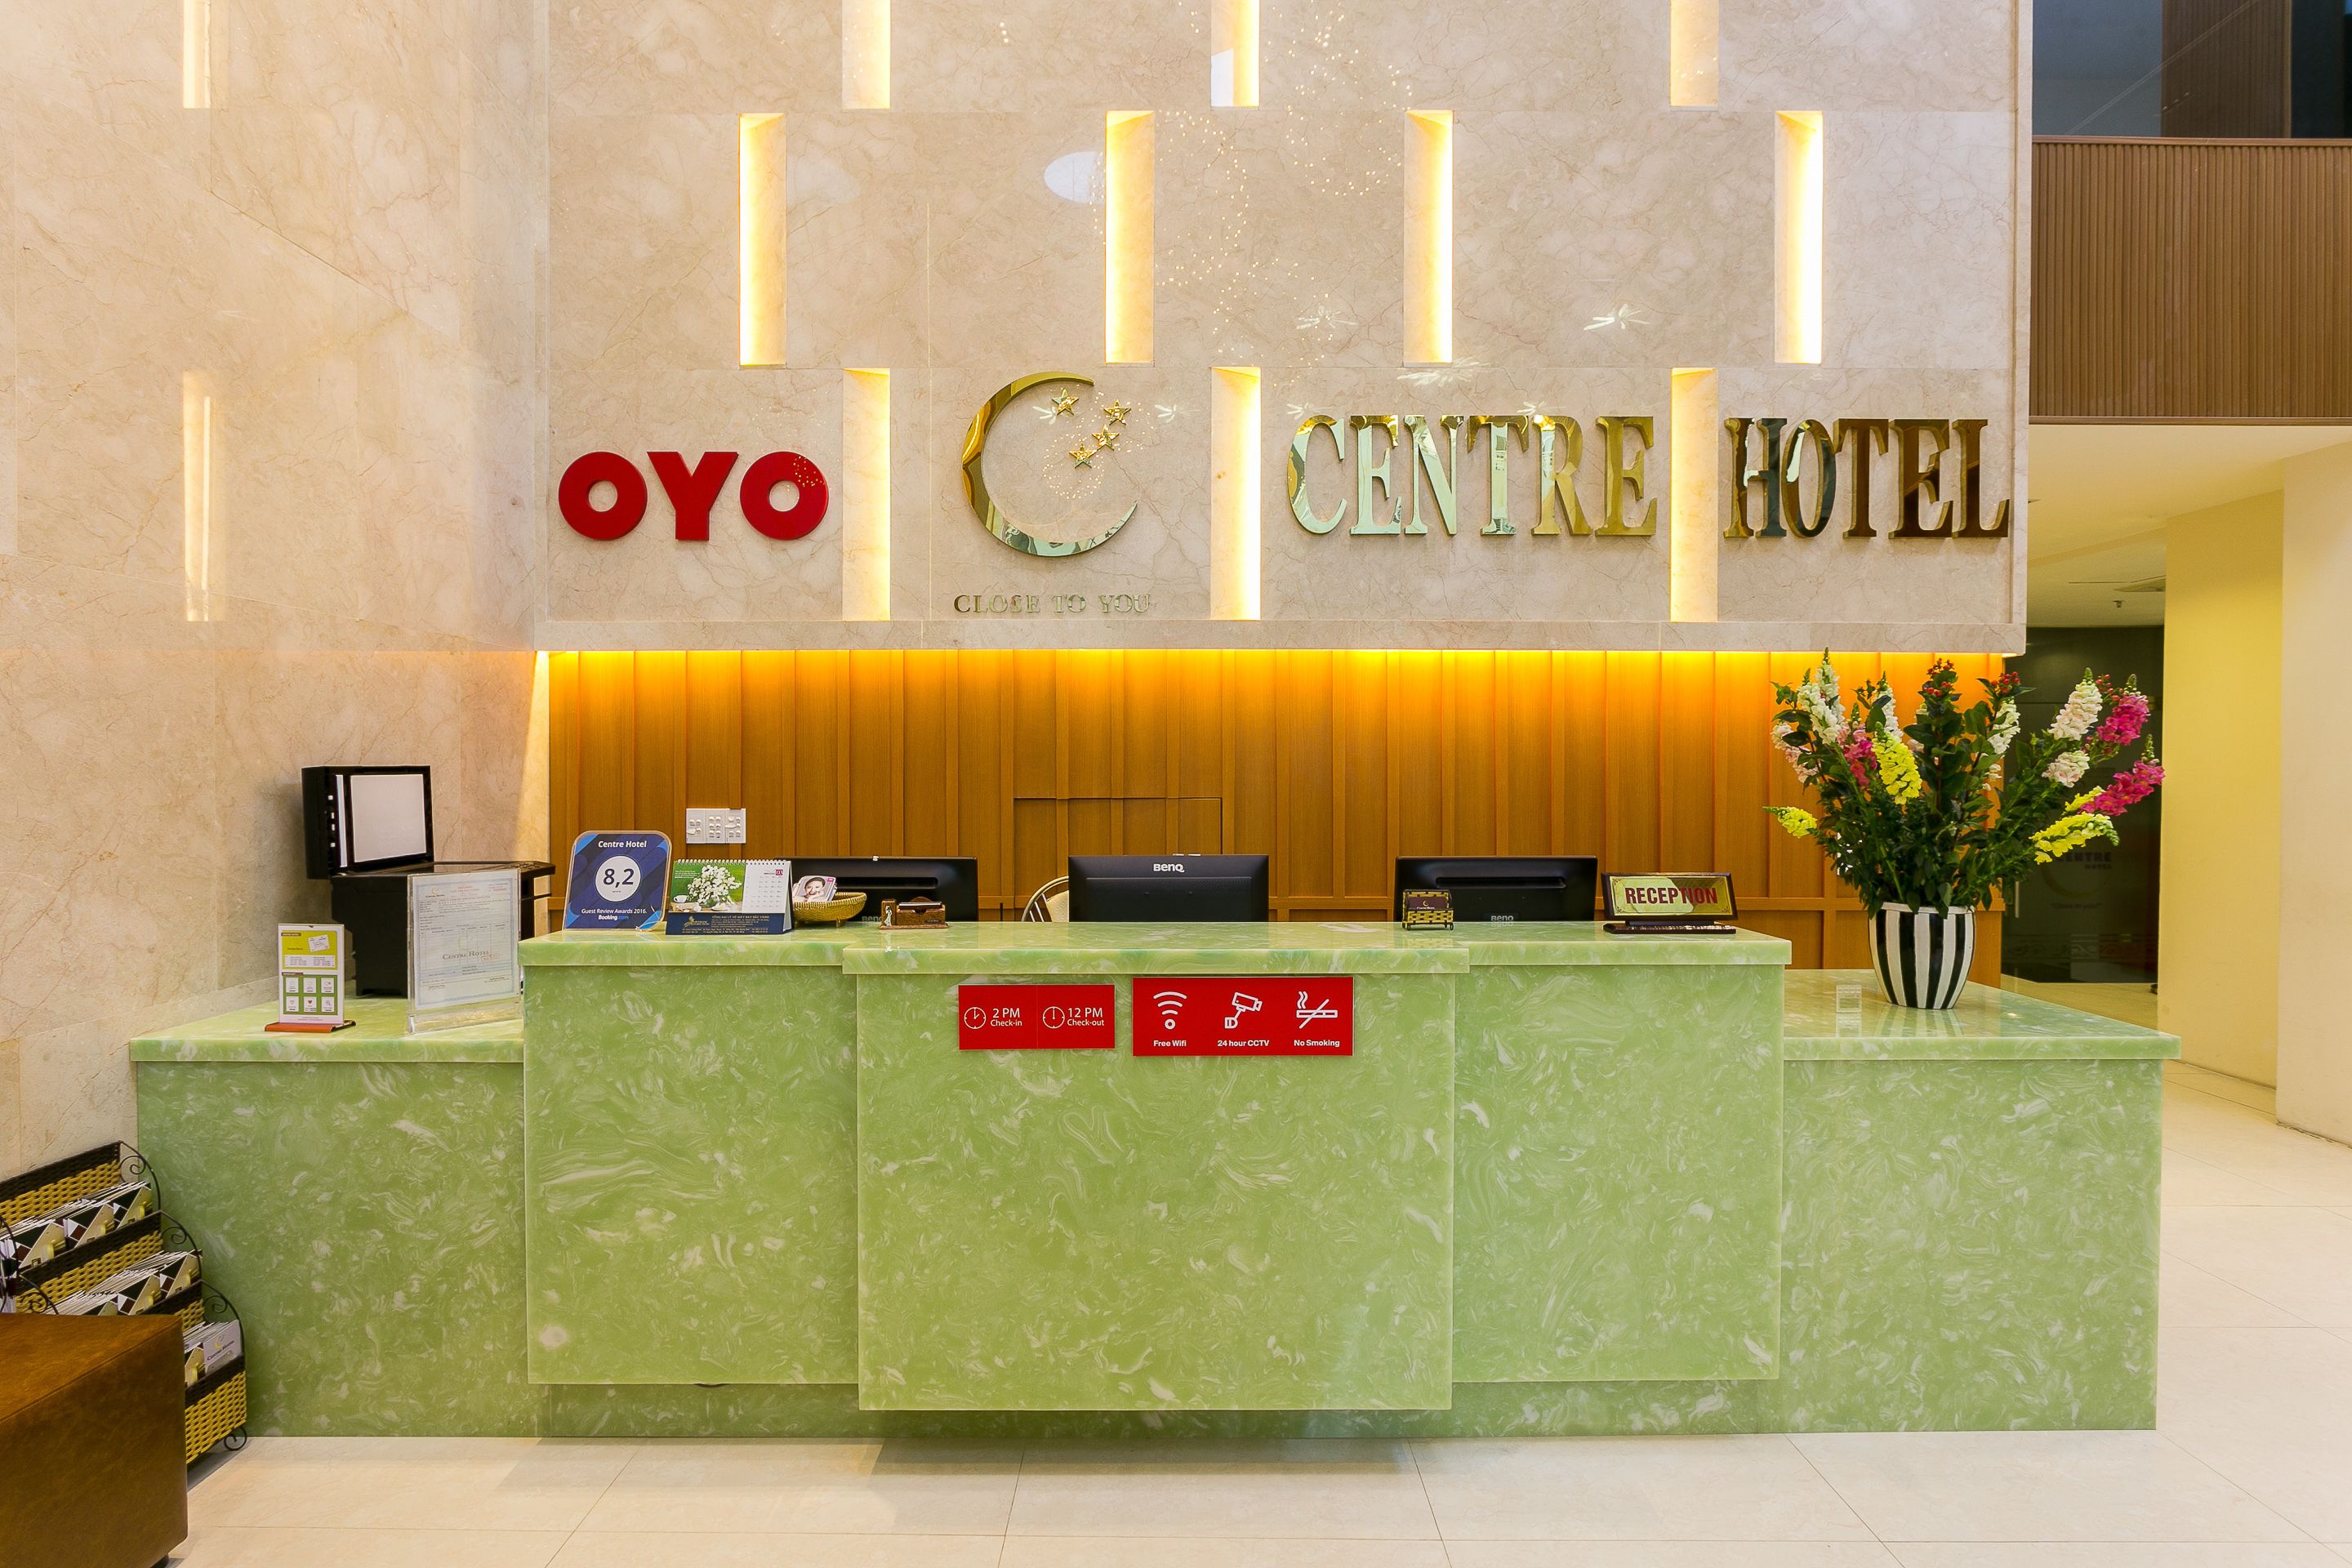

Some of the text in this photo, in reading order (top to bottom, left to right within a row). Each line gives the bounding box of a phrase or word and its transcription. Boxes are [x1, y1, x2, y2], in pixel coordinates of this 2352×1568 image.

[1287, 415, 2010, 539] CENTRE HOTEL
[559, 451, 829, 541] OYO
[954, 594, 1151, 613] CLOSE TO YOU
[1153, 863, 1185, 873] BenQ
[603, 868, 635, 888] 8,2
[1624, 887, 1718, 904] RECEPTION
[992, 1008, 1020, 1018] 2 PM
[1068, 1007, 1102, 1018] 12 PM
[990, 1018, 1022, 1027] Check-in
[1067, 1018, 1105, 1027] Check-out
[1294, 1039, 1340, 1048] No Smoking
